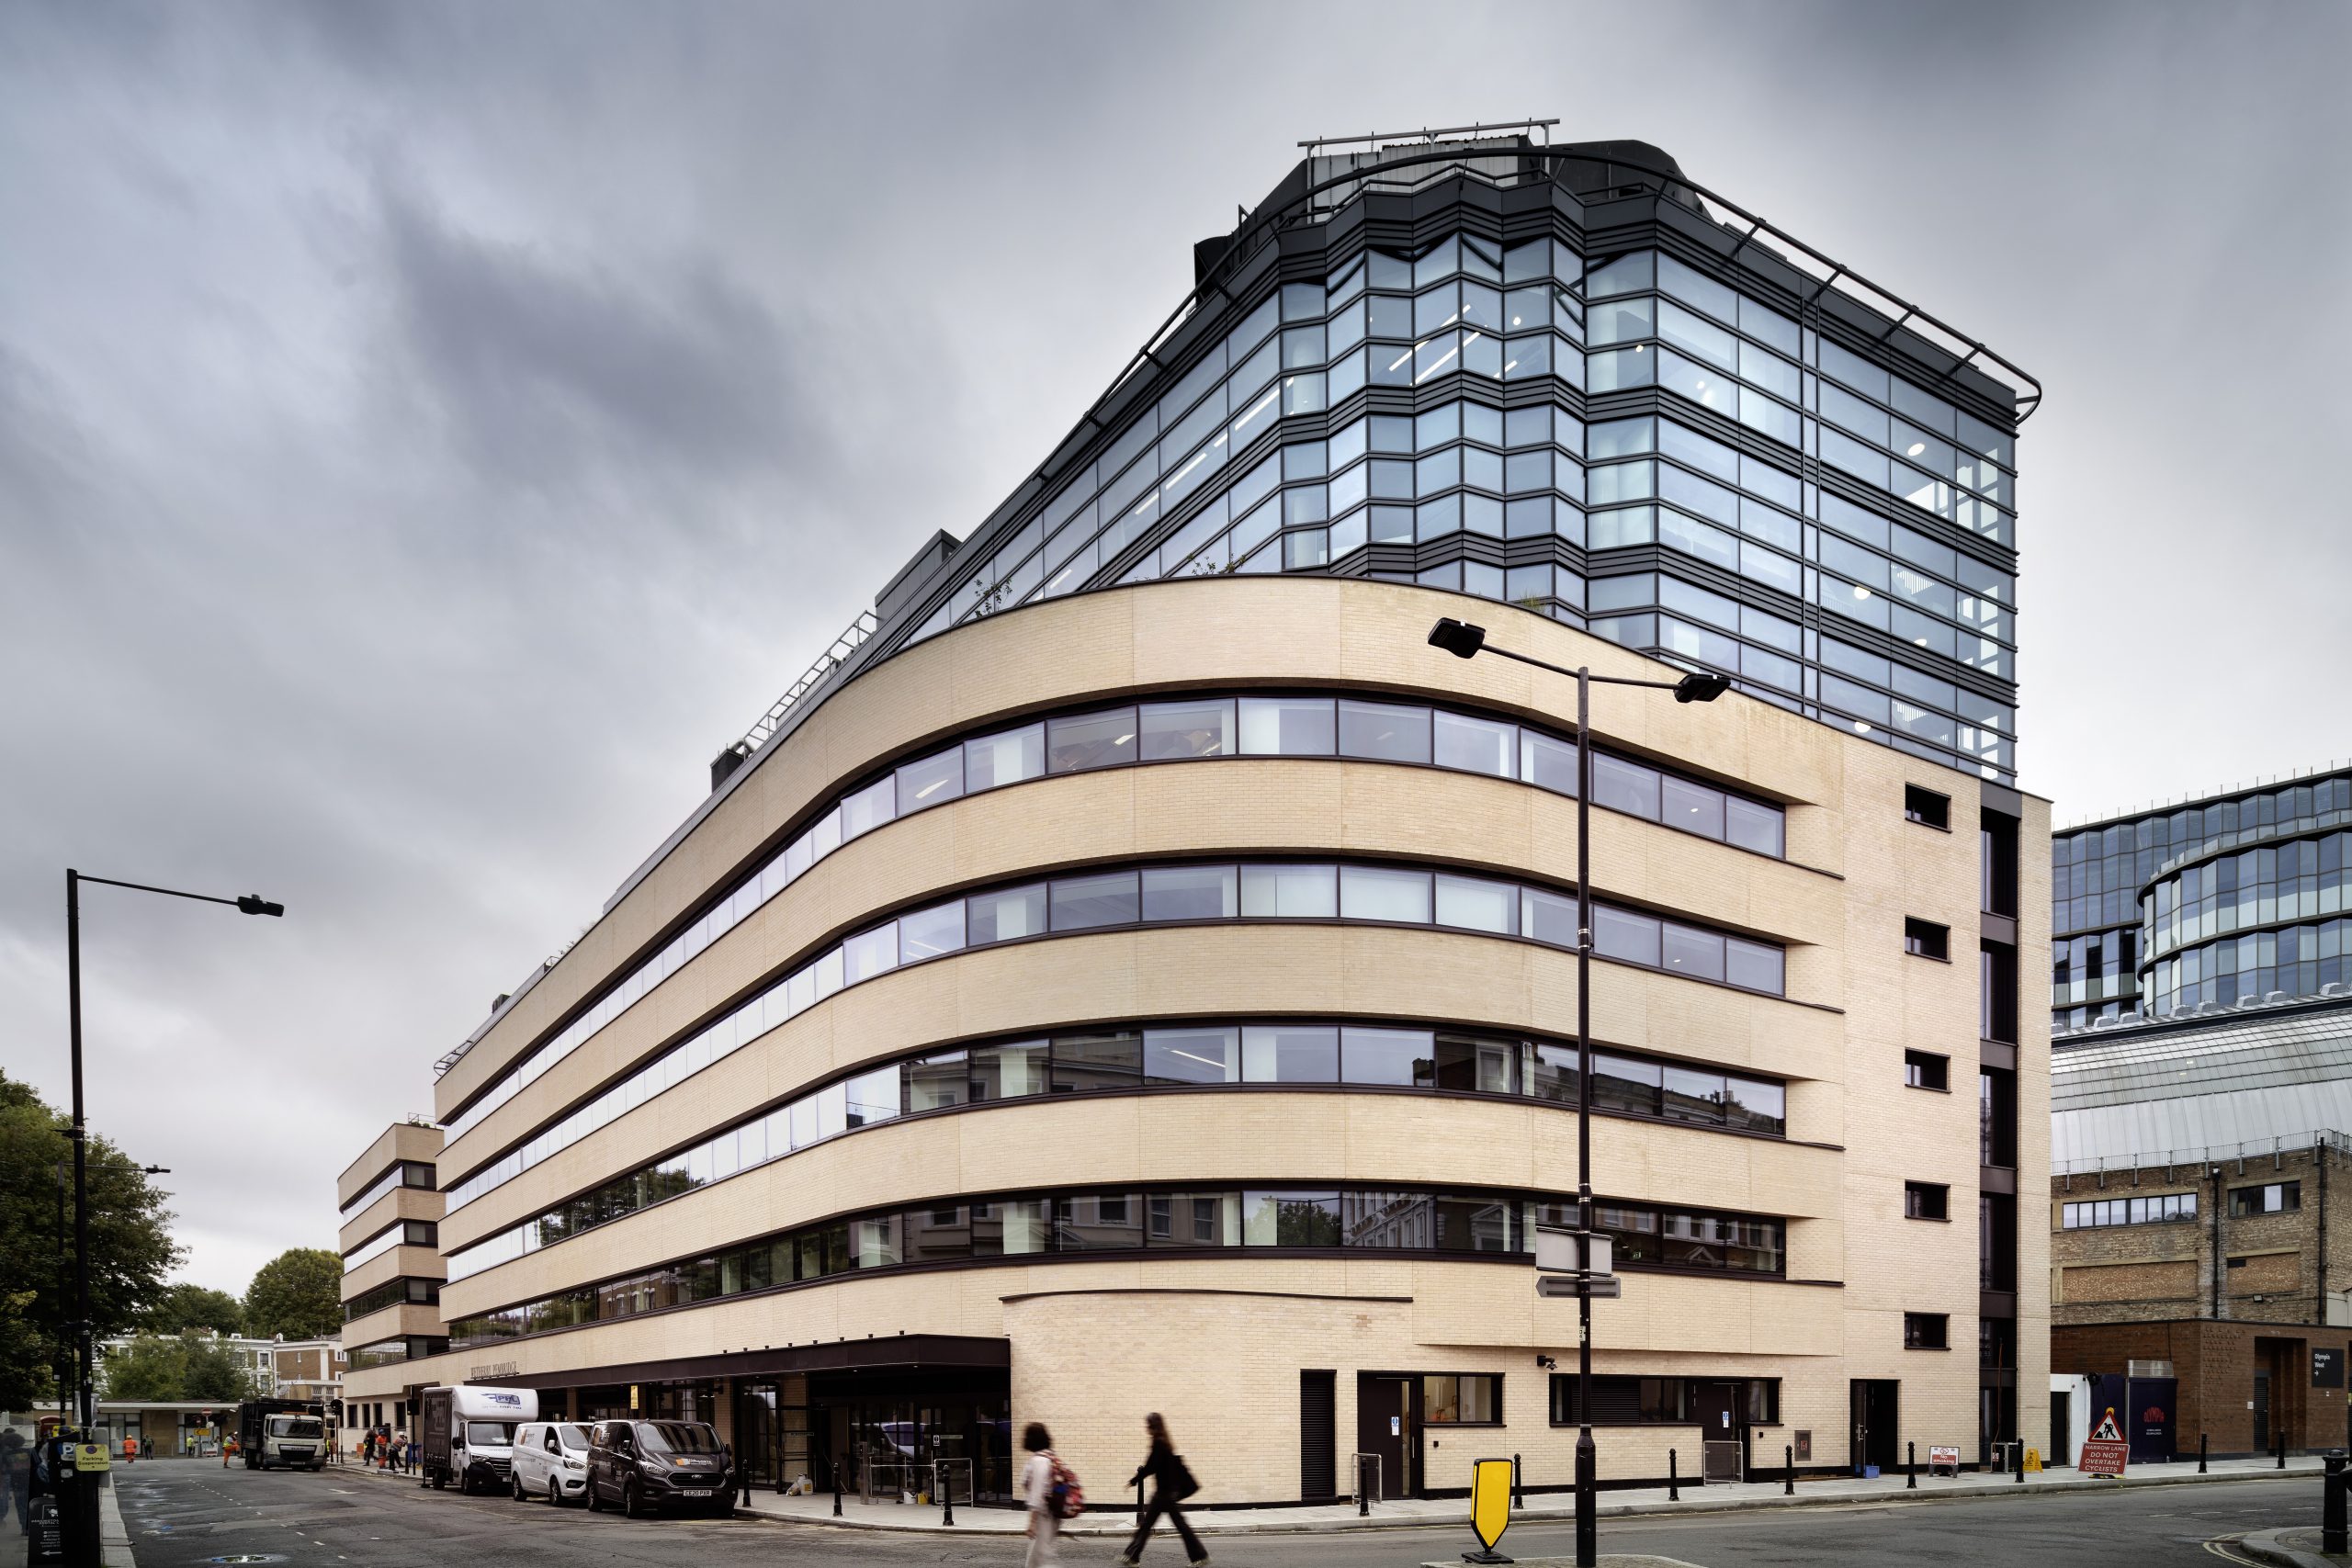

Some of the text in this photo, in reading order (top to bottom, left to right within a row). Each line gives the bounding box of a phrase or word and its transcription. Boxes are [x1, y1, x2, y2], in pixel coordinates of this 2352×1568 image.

[2314, 1353, 2331, 1361] Olympia
[2143, 1406, 2165, 1423] OLYMPIA
[2085, 1458, 2121, 1466] OVERTAKE
